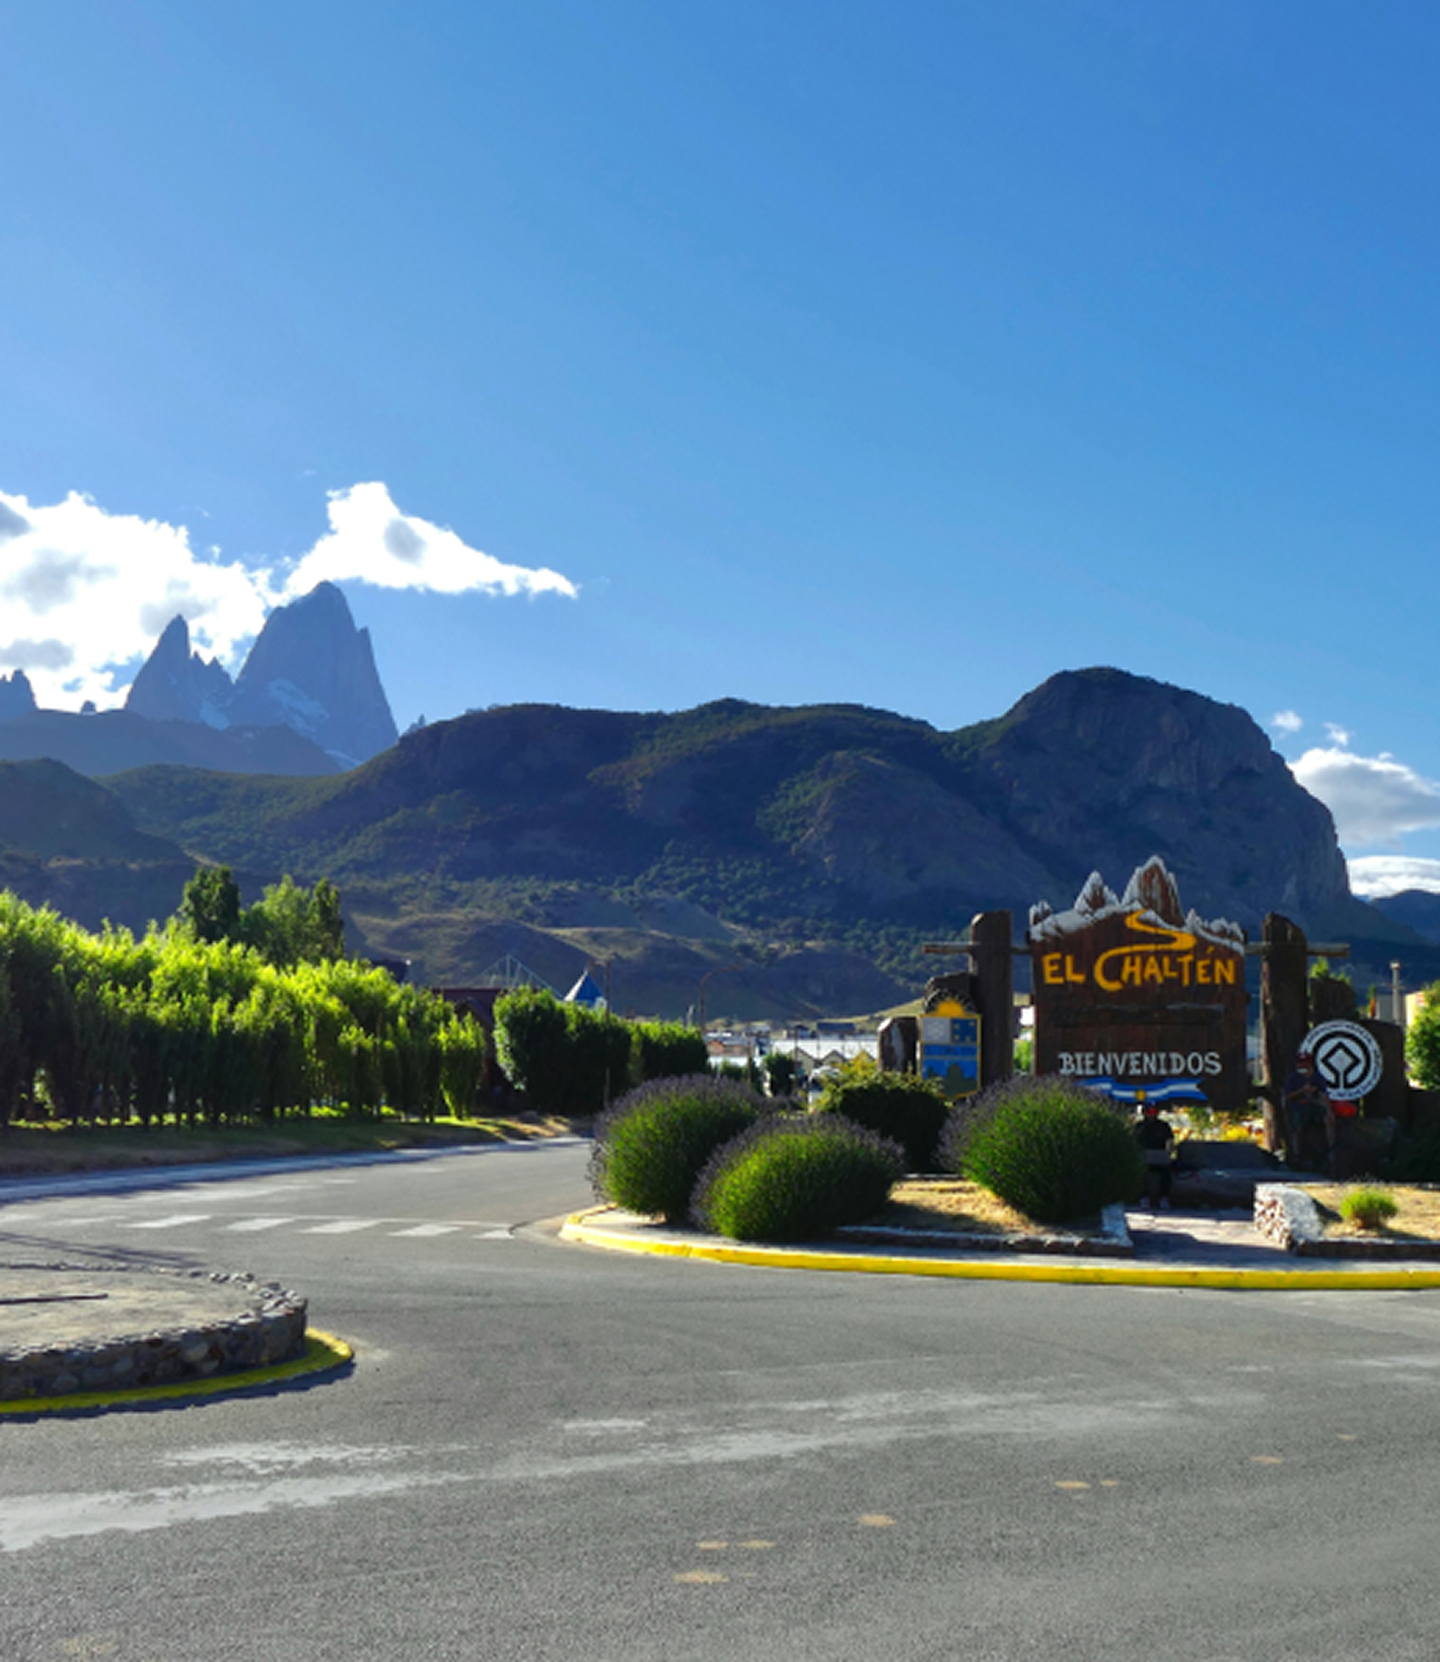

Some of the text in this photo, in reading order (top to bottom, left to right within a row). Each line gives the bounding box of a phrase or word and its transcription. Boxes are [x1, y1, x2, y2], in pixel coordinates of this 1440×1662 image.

[1042, 945, 1235, 991] EL CHALTÉN
[1058, 1051, 1222, 1075] BIENVENIDOS
